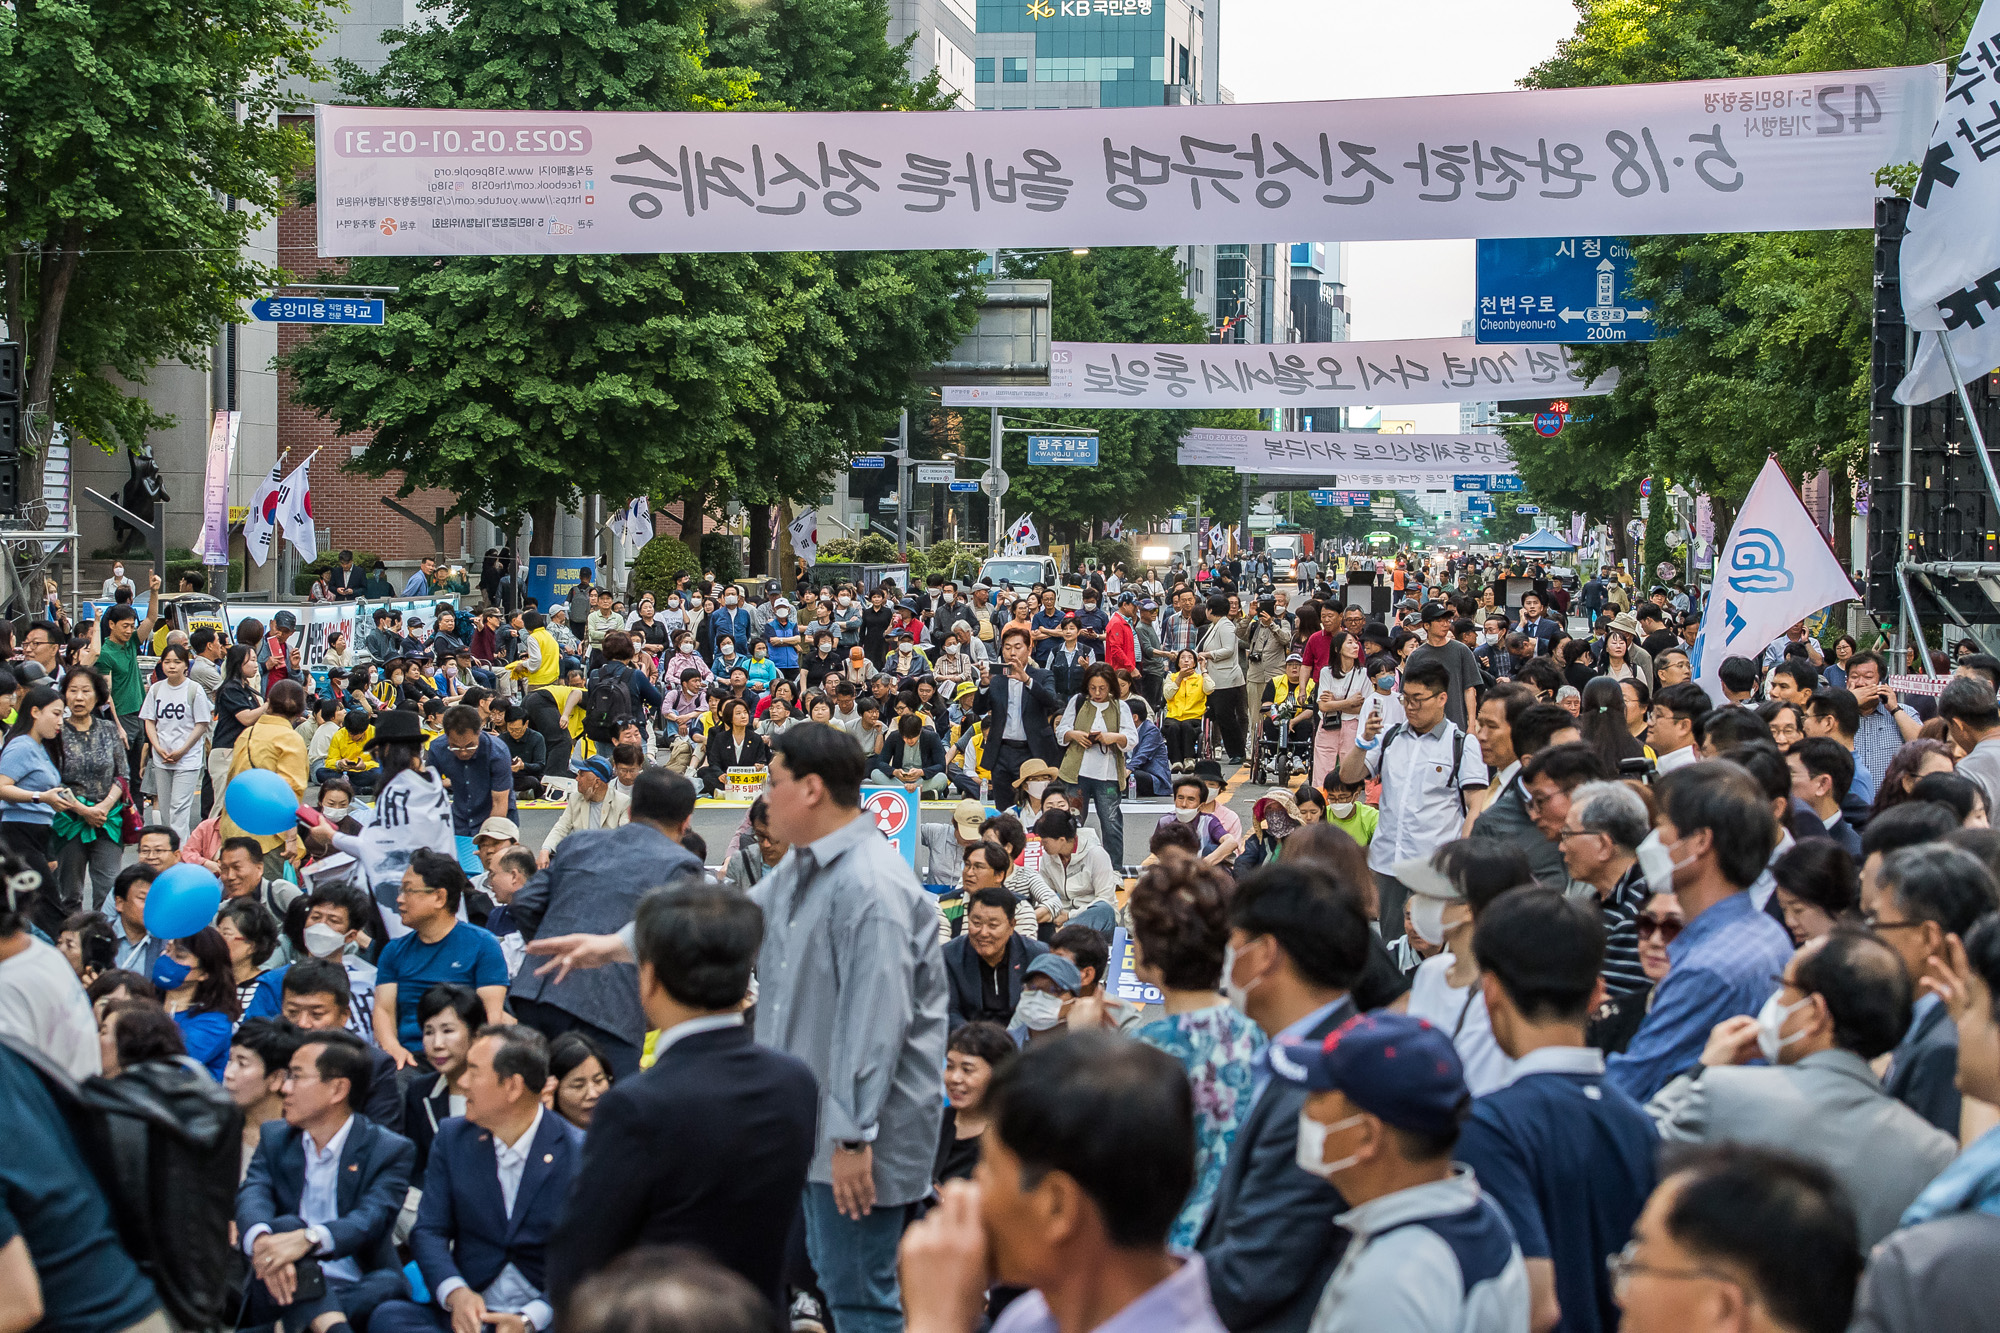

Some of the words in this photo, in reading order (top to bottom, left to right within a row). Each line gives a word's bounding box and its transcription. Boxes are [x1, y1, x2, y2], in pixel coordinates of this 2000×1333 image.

[1061, 1, 1090, 17] KB
[1093, 0, 1152, 16] 국민은행
[1556, 238, 1600, 258] 시청
[1600, 275, 1612, 303] 금남로
[268, 302, 326, 318] 중앙미용
[344, 304, 372, 318] 학교
[1480, 296, 1556, 315] 천변우로
[328, 312, 342, 320] 전문
[1590, 311, 1622, 320] 중앙로
[1480, 318, 1556, 332] Cheonbyeonu-ro
[1586, 328, 1626, 340] 200m
[1037, 439, 1089, 451] 광주일보
[156, 699, 185, 720] Lee
